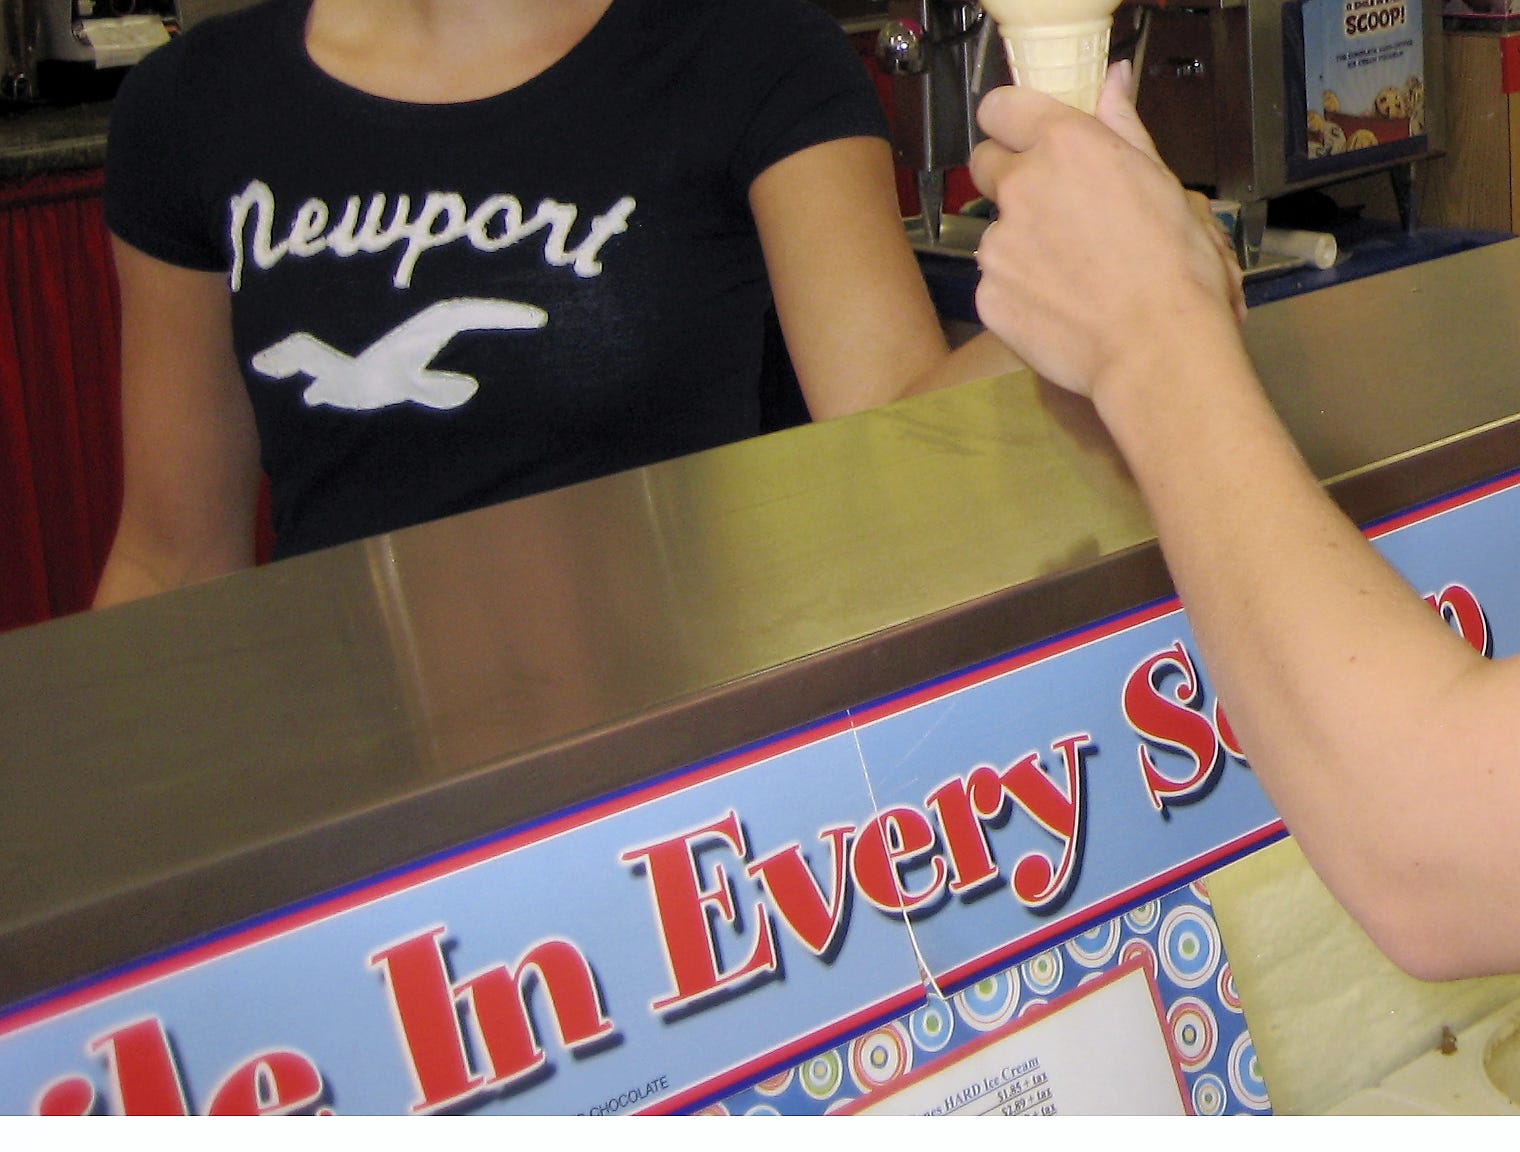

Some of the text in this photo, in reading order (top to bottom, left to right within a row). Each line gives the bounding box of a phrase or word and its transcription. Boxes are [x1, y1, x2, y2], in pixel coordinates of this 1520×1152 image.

[1346, 6, 1405, 35] SCOOP!
[230, 178, 636, 292] Newport
[367, 925, 615, 1113] In
[621, 734, 1092, 1015] Every
[589, 1075, 669, 1116] CHOCOLATE
[944, 1057, 1040, 1112] HARD Ice Cream
[997, 1085, 1021, 1102] $1.85
[1033, 1072, 1048, 1084] tax
[1037, 1087, 1053, 1100] tax
[1041, 1103, 1057, 1116] tax
